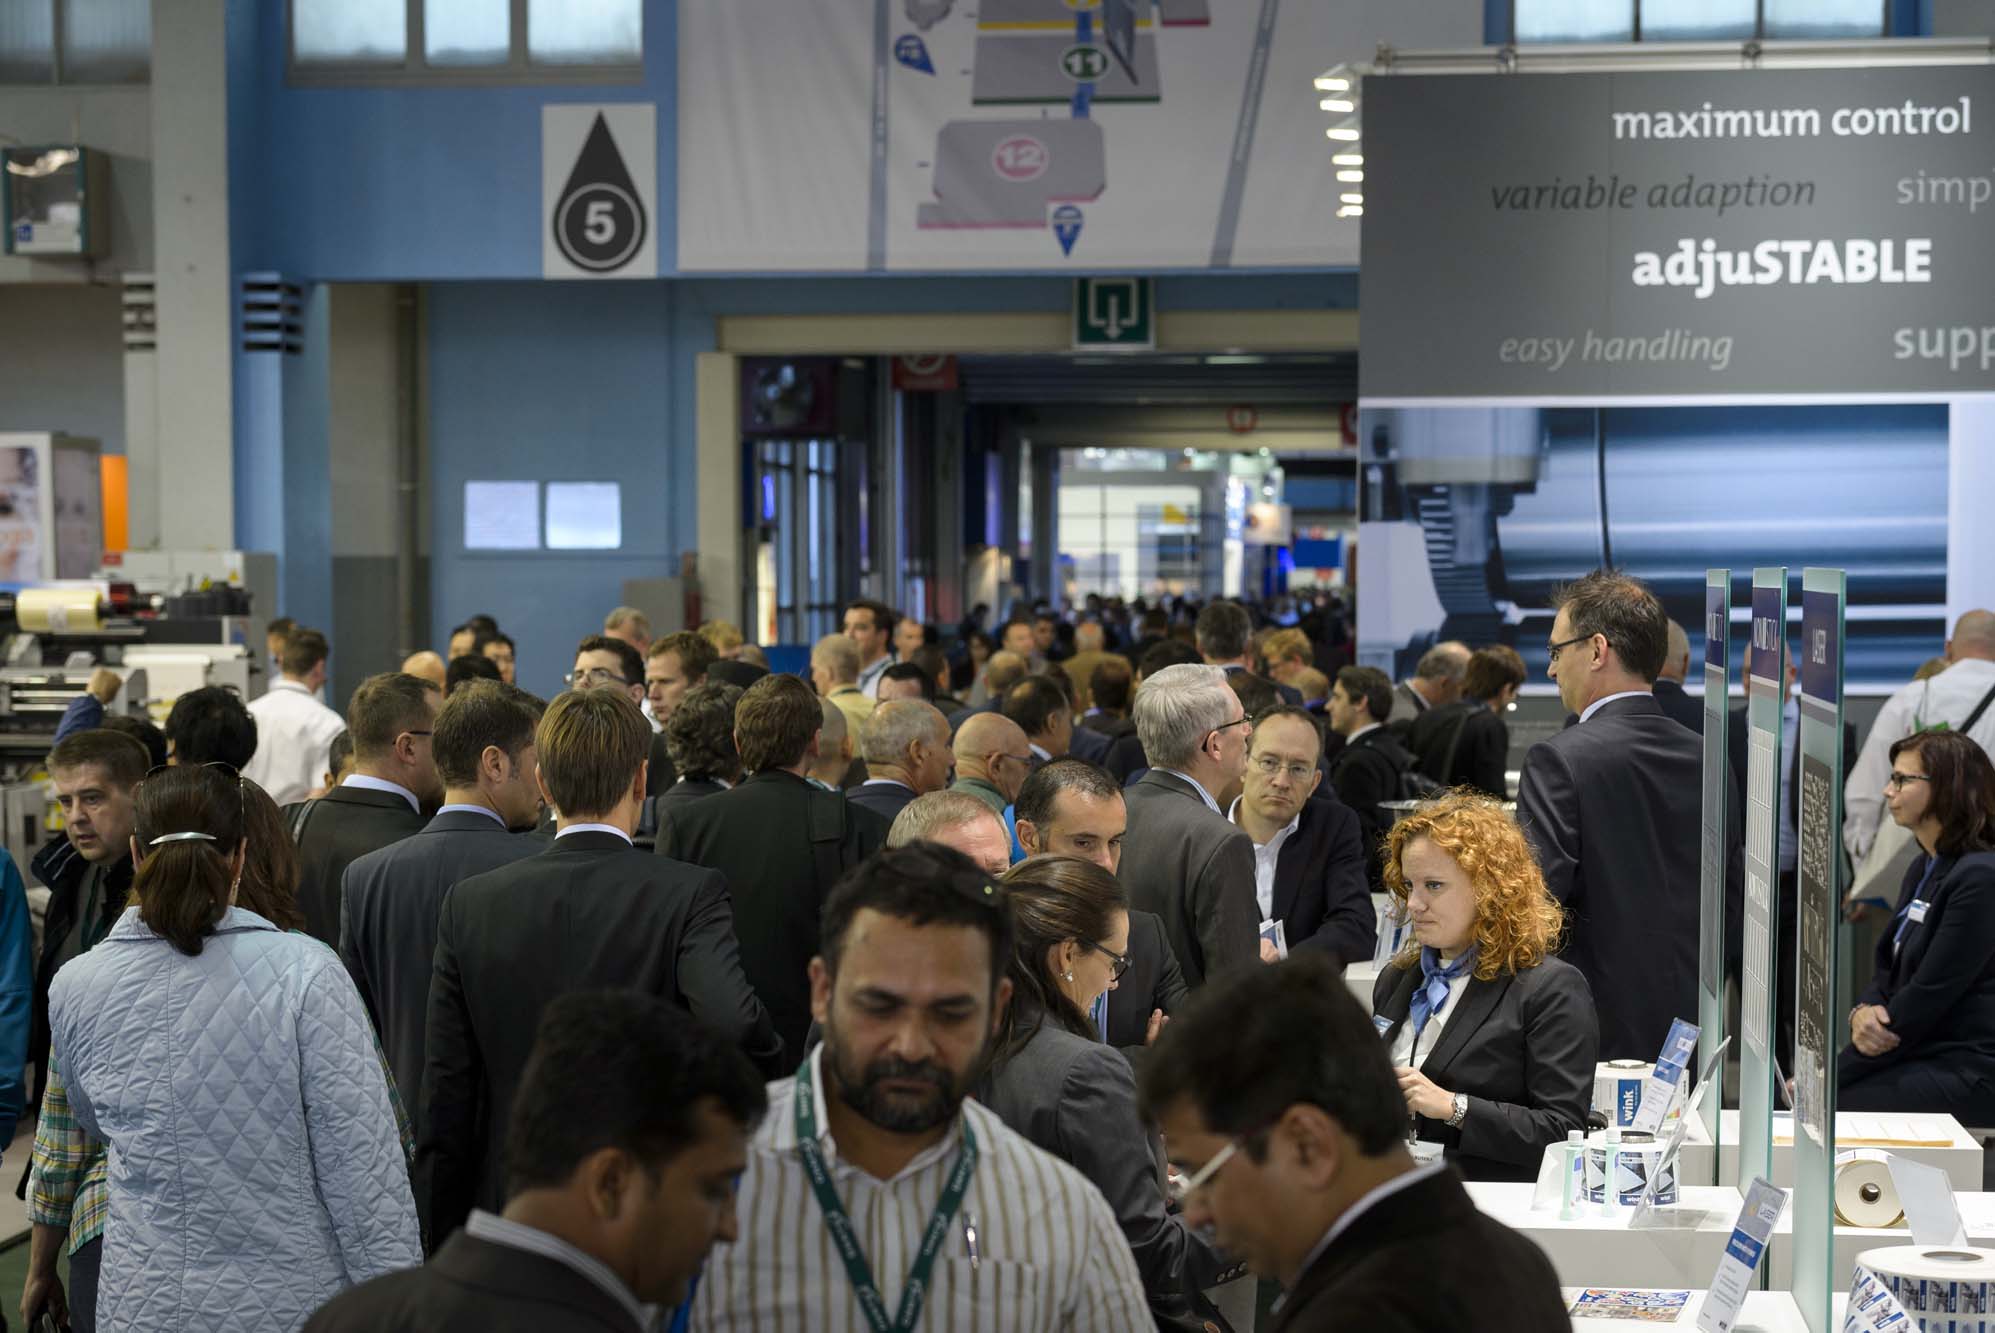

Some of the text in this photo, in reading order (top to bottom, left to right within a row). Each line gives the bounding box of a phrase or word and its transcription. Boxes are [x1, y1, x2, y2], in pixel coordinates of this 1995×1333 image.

[1067, 52, 1105, 73] 11
[1614, 97, 1971, 139] maximum control
[1000, 144, 1042, 168] 12
[1491, 174, 1816, 217] variable adaption
[1896, 168, 1995, 214] simp
[584, 201, 616, 245] 5
[1632, 238, 1933, 298] adjuSTABLE
[1499, 329, 1734, 373] easy handling
[1622, 1089, 1634, 1122] wink
